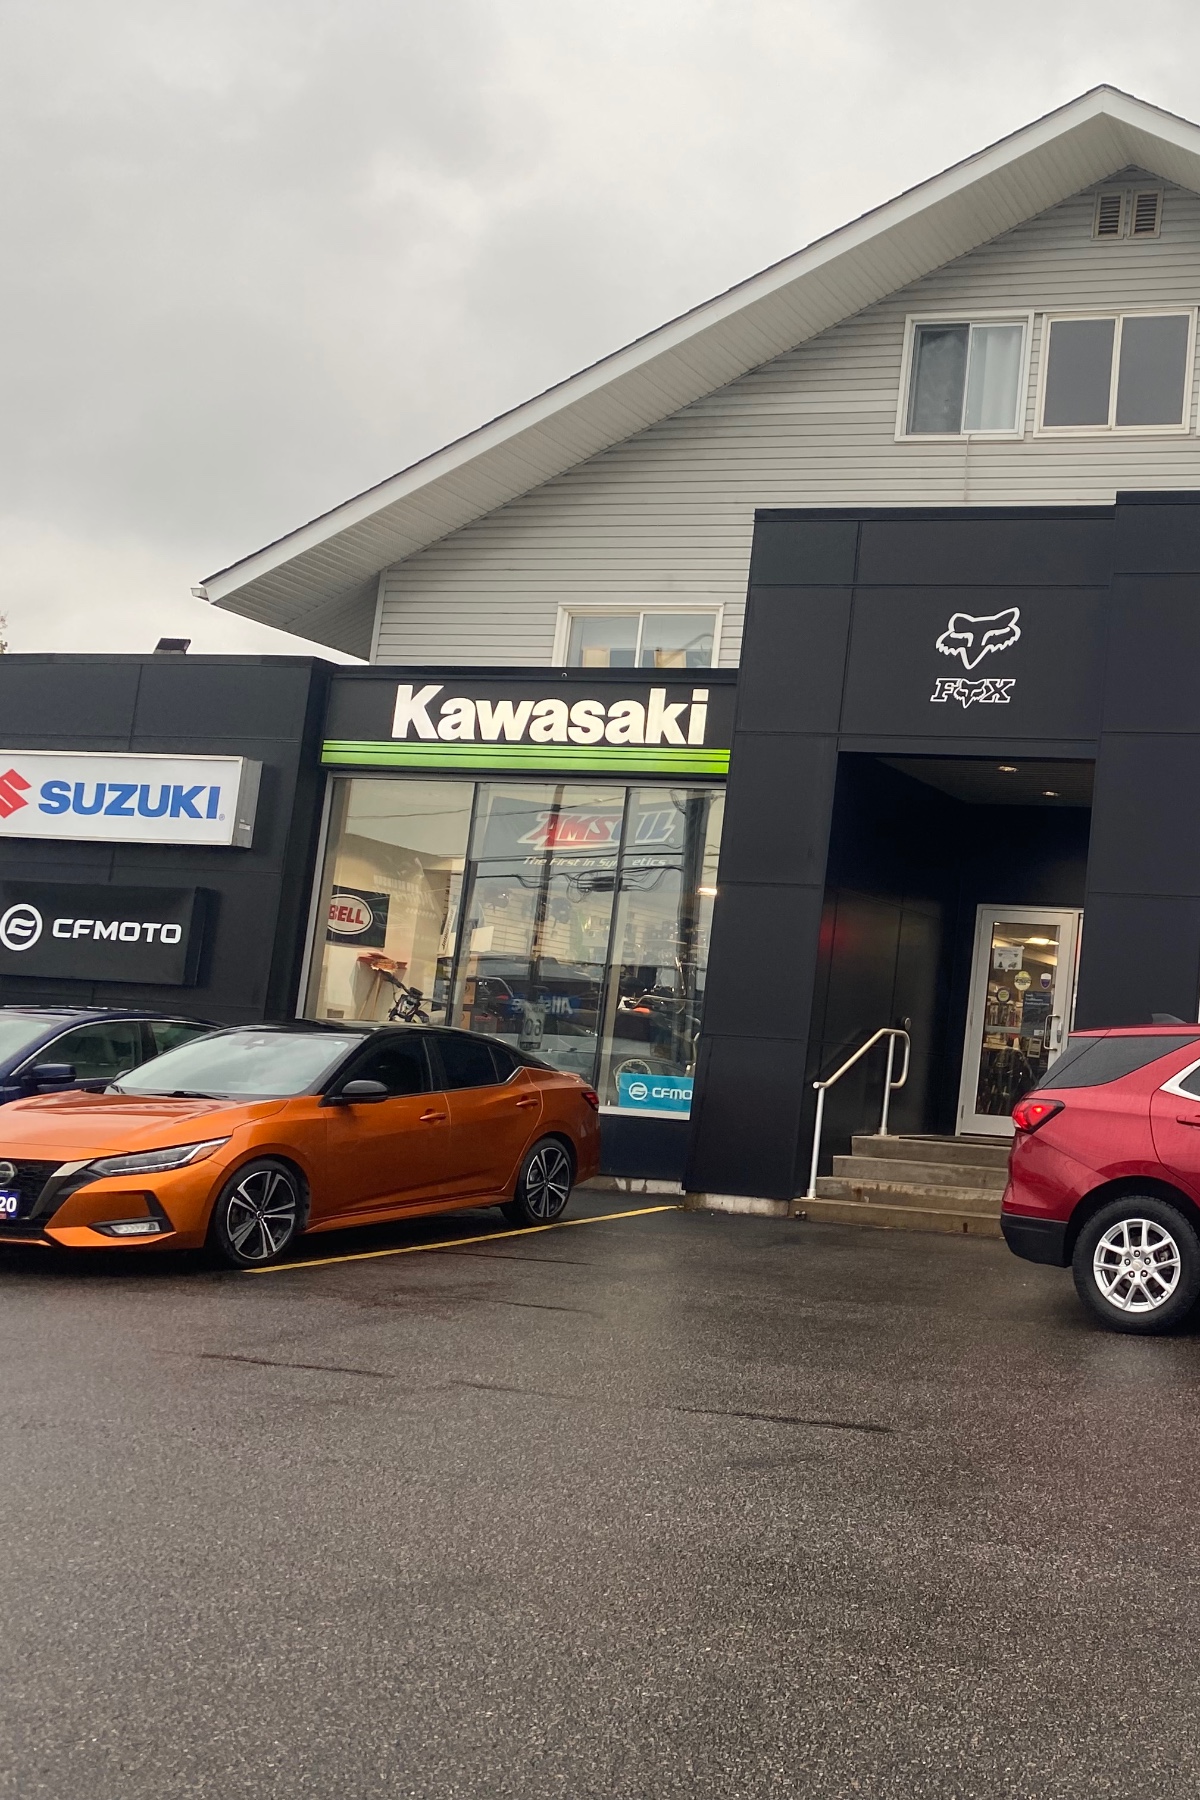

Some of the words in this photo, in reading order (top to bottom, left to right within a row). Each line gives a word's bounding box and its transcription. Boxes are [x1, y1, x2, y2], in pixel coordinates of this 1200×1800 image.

[391, 684, 709, 745] Kawasaki
[38, 780, 221, 820] SUZUKI
[523, 856, 547, 866] The
[550, 857, 580, 867] First
[328, 904, 364, 925] BELL
[52, 918, 182, 944] CFMOTO
